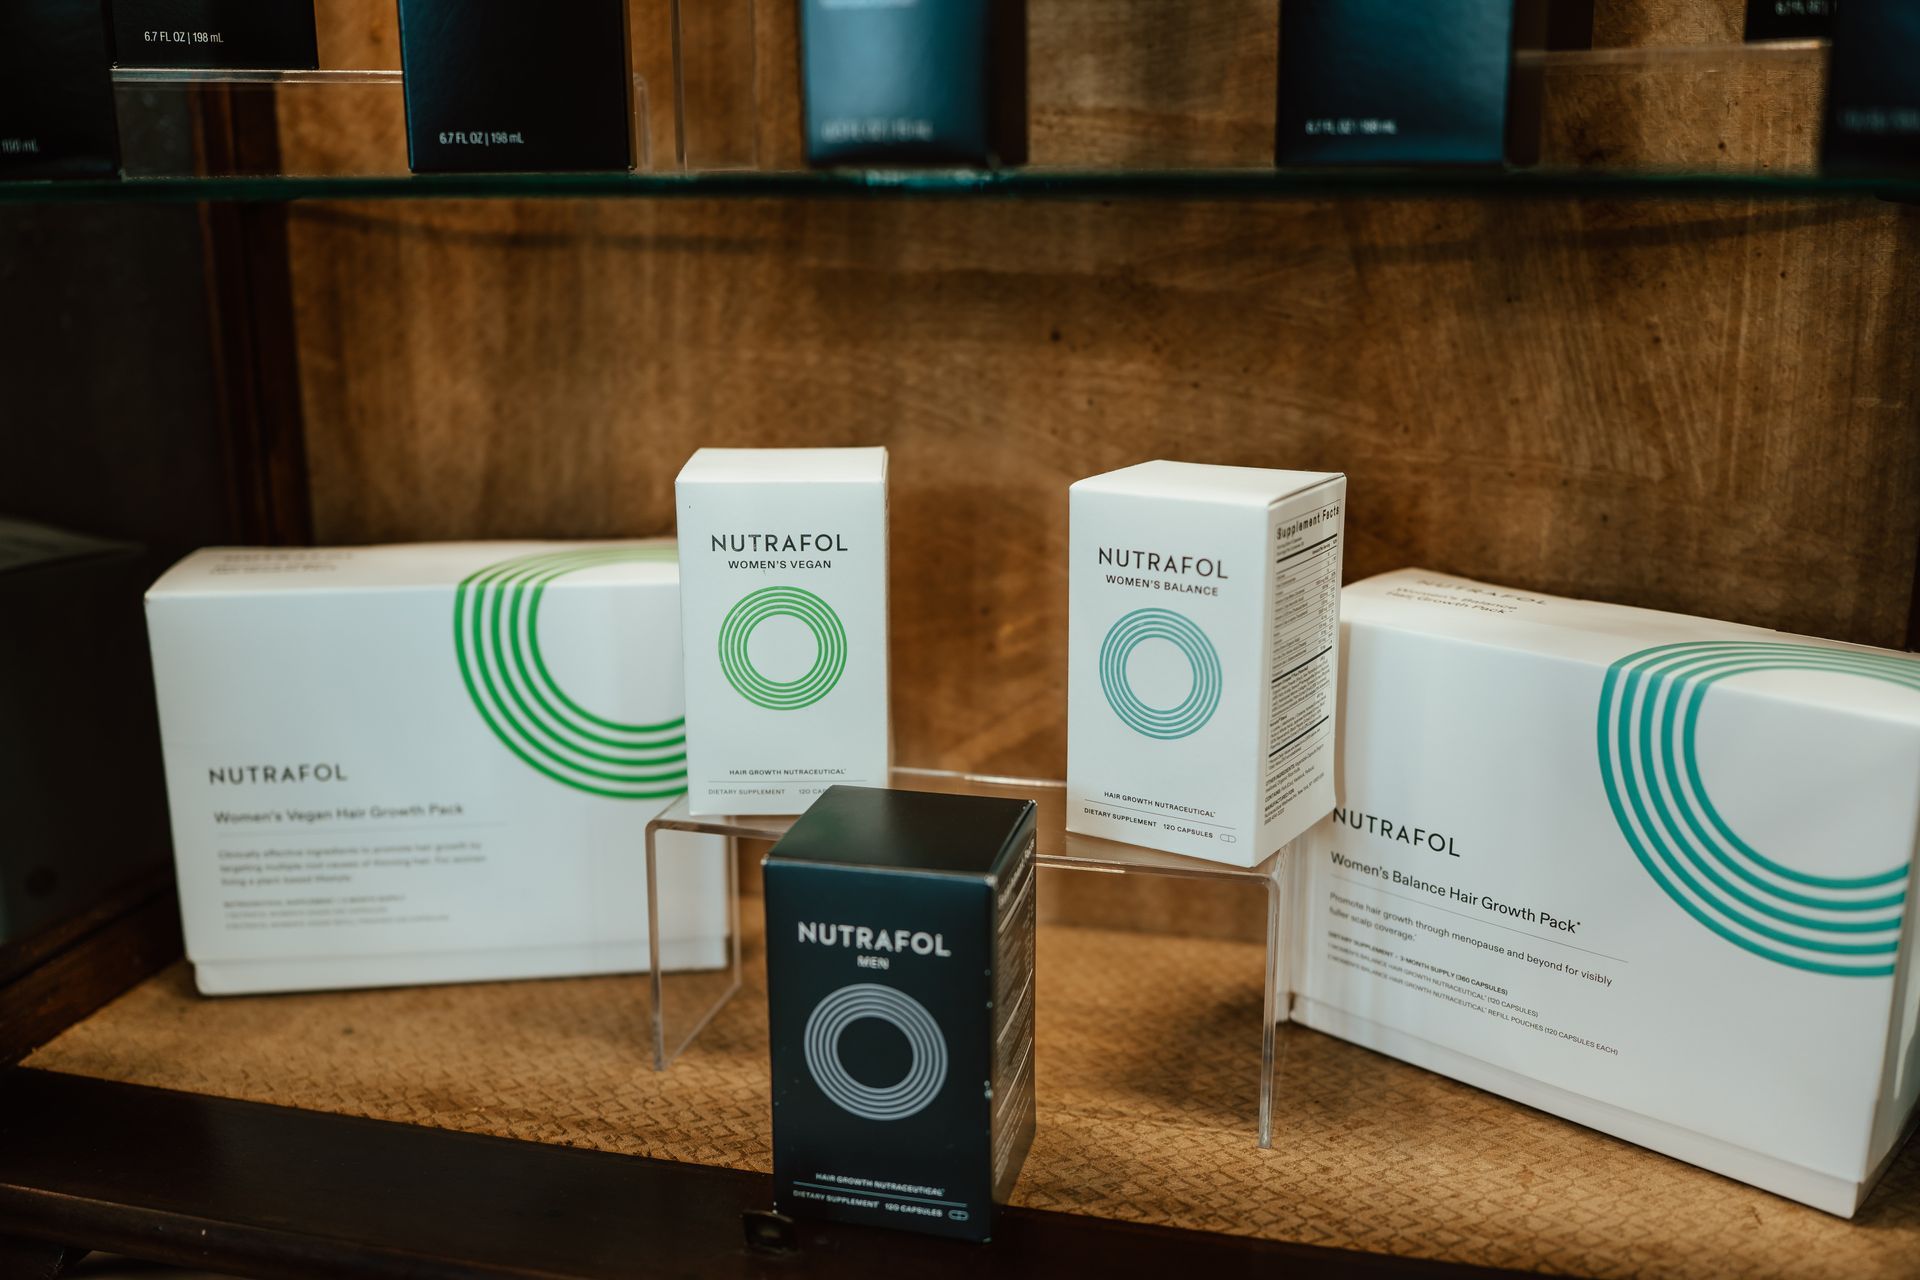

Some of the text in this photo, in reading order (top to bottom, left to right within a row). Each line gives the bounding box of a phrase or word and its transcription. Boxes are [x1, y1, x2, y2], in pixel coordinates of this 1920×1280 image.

[144, 31, 158, 42] 6.7
[160, 32, 171, 42] FL
[173, 32, 185, 42] OZ
[193, 32, 208, 42] 198
[210, 32, 224, 42] mL
[456, 132, 468, 144] FL
[470, 132, 483, 144] OZ
[509, 132, 524, 144] mL
[1276, 505, 1339, 540] Supplement Facts
[712, 534, 848, 552] NUTRAFOL
[728, 560, 831, 569] WOMEN'S VEGAN
[1098, 546, 1228, 579] NUTRAFOL
[1106, 574, 1218, 596] WOMEN'S BALANCE
[208, 763, 347, 785] NUTRAFOL
[1104, 791, 1121, 799] HAIR
[1122, 794, 1153, 806] GROWTH
[1084, 808, 1111, 818] DIETARY
[1112, 813, 1157, 827] SUPPLEMENT
[1177, 826, 1213, 838] CAPSULES
[1333, 807, 1460, 858] NUTRAFOL
[1330, 850, 1389, 880] Women's
[1392, 870, 1446, 896] Balance
[1449, 886, 1478, 905] Hair
[1481, 896, 1535, 922] Growth
[1350, 914, 1372, 928] scalp
[798, 920, 952, 958] NUTRAFOL
[1330, 891, 1612, 987] Promote hair growth through menopause and beyond for visibly
[857, 954, 890, 970] MEN
[1430, 965, 1455, 978] SUPPLY
[1456, 974, 1470, 983] (360
[1470, 979, 1508, 996] CAPSULES)
[1501, 1001, 1538, 1018] CAPSULES)
[1488, 1008, 1509, 1021] REFILL
[1511, 1016, 1544, 1032] POUCHES
[1544, 1027, 1558, 1036] (120
[1558, 1031, 1595, 1048] CAPSULES
[1596, 1043, 1618, 1056] EACH)
[815, 1172, 836, 1182] HAIR
[837, 1175, 873, 1187] GROWTH
[826, 1194, 880, 1209] SUPPLEMENT
[900, 1204, 943, 1217] CAPSULES
